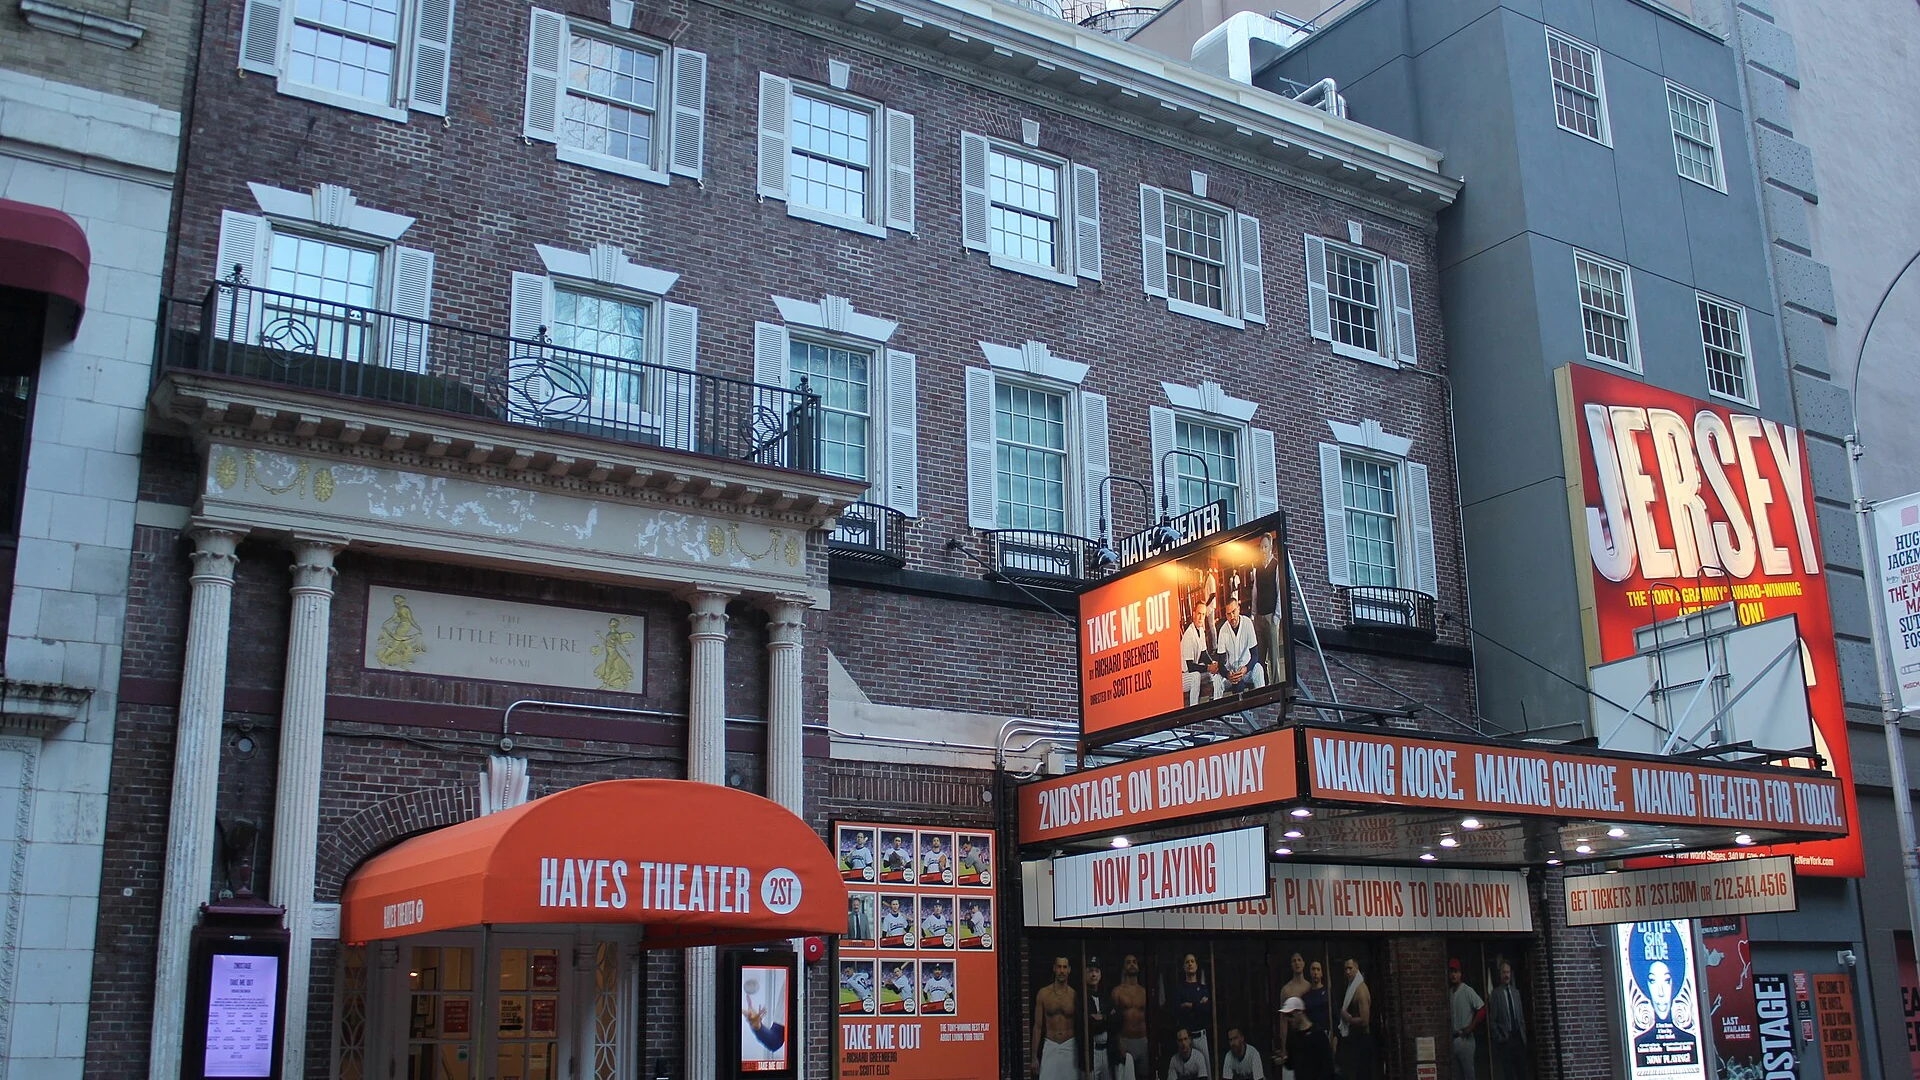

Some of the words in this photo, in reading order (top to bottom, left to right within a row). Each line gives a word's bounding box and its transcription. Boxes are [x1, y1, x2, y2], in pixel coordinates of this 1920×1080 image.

[1584, 403, 1819, 582] JERSEY
[1165, 503, 1221, 551] HEATER
[1895, 531, 1920, 551] HUG
[1626, 591, 1648, 607] THE
[1650, 589, 1674, 605] TONY
[1732, 582, 1802, 600] AWARD-WINNING
[1888, 584, 1910, 604] THE
[1087, 610, 1118, 655] TAKE
[1121, 601, 1143, 644] ME
[1146, 590, 1170, 635] OUT
[437, 625, 498, 645] LITTLE
[507, 632, 581, 653] THEATRE
[1089, 669, 1094, 680] BY
[1094, 653, 1121, 679] RICHARD
[1123, 640, 1159, 670] GREENBERG
[1090, 690, 1106, 706] DIRECTED
[1113, 675, 1133, 699] SCOTT
[1134, 669, 1152, 692] ELLIS
[1038, 774, 1123, 831] 2NDSTAGE
[1128, 767, 1152, 814] ON
[1158, 745, 1265, 809] BROADWAY
[1313, 737, 1396, 796] MAKING
[1402, 745, 1464, 801] NOISE.
[1475, 753, 1551, 807] MAKING
[1552, 760, 1624, 812] CHANGE.
[1631, 767, 1697, 817] MAKING
[1698, 773, 1763, 821] THEATER
[1763, 779, 1794, 824] FOR
[1794, 782, 1842, 827] TODAY.
[1093, 855, 1131, 907] NOW
[1138, 842, 1216, 902] PLAYING
[1794, 856, 1834, 866] sNewYork.com
[540, 858, 628, 909] HAYES
[640, 861, 749, 914] THEATER
[769, 877, 794, 905] 2ST
[1284, 878, 1325, 916] PLAY
[1333, 879, 1404, 918] RETURNS
[1408, 881, 1429, 918] TO
[1434, 882, 1511, 918] BROADWAY
[1570, 890, 1588, 912] GET
[1591, 887, 1632, 910] TICKETS
[1635, 885, 1647, 907] AT
[1650, 880, 1698, 906] 2ST.COM
[1701, 886, 1712, 901] OR
[1714, 872, 1787, 901] 212.541.4516
[1637, 920, 1671, 933] LITTLE
[1643, 931, 1667, 946] GIRL
[1644, 945, 1669, 960] BLUE
[1721, 1016, 1739, 1026] LAST
[1723, 1024, 1751, 1033] AVAILABLE
[843, 1024, 872, 1050] TAKE
[876, 1024, 895, 1050] ME
[899, 1023, 921, 1050] OUT
[859, 1065, 876, 1076] SCOTT
[876, 1065, 890, 1076] ELLIS
